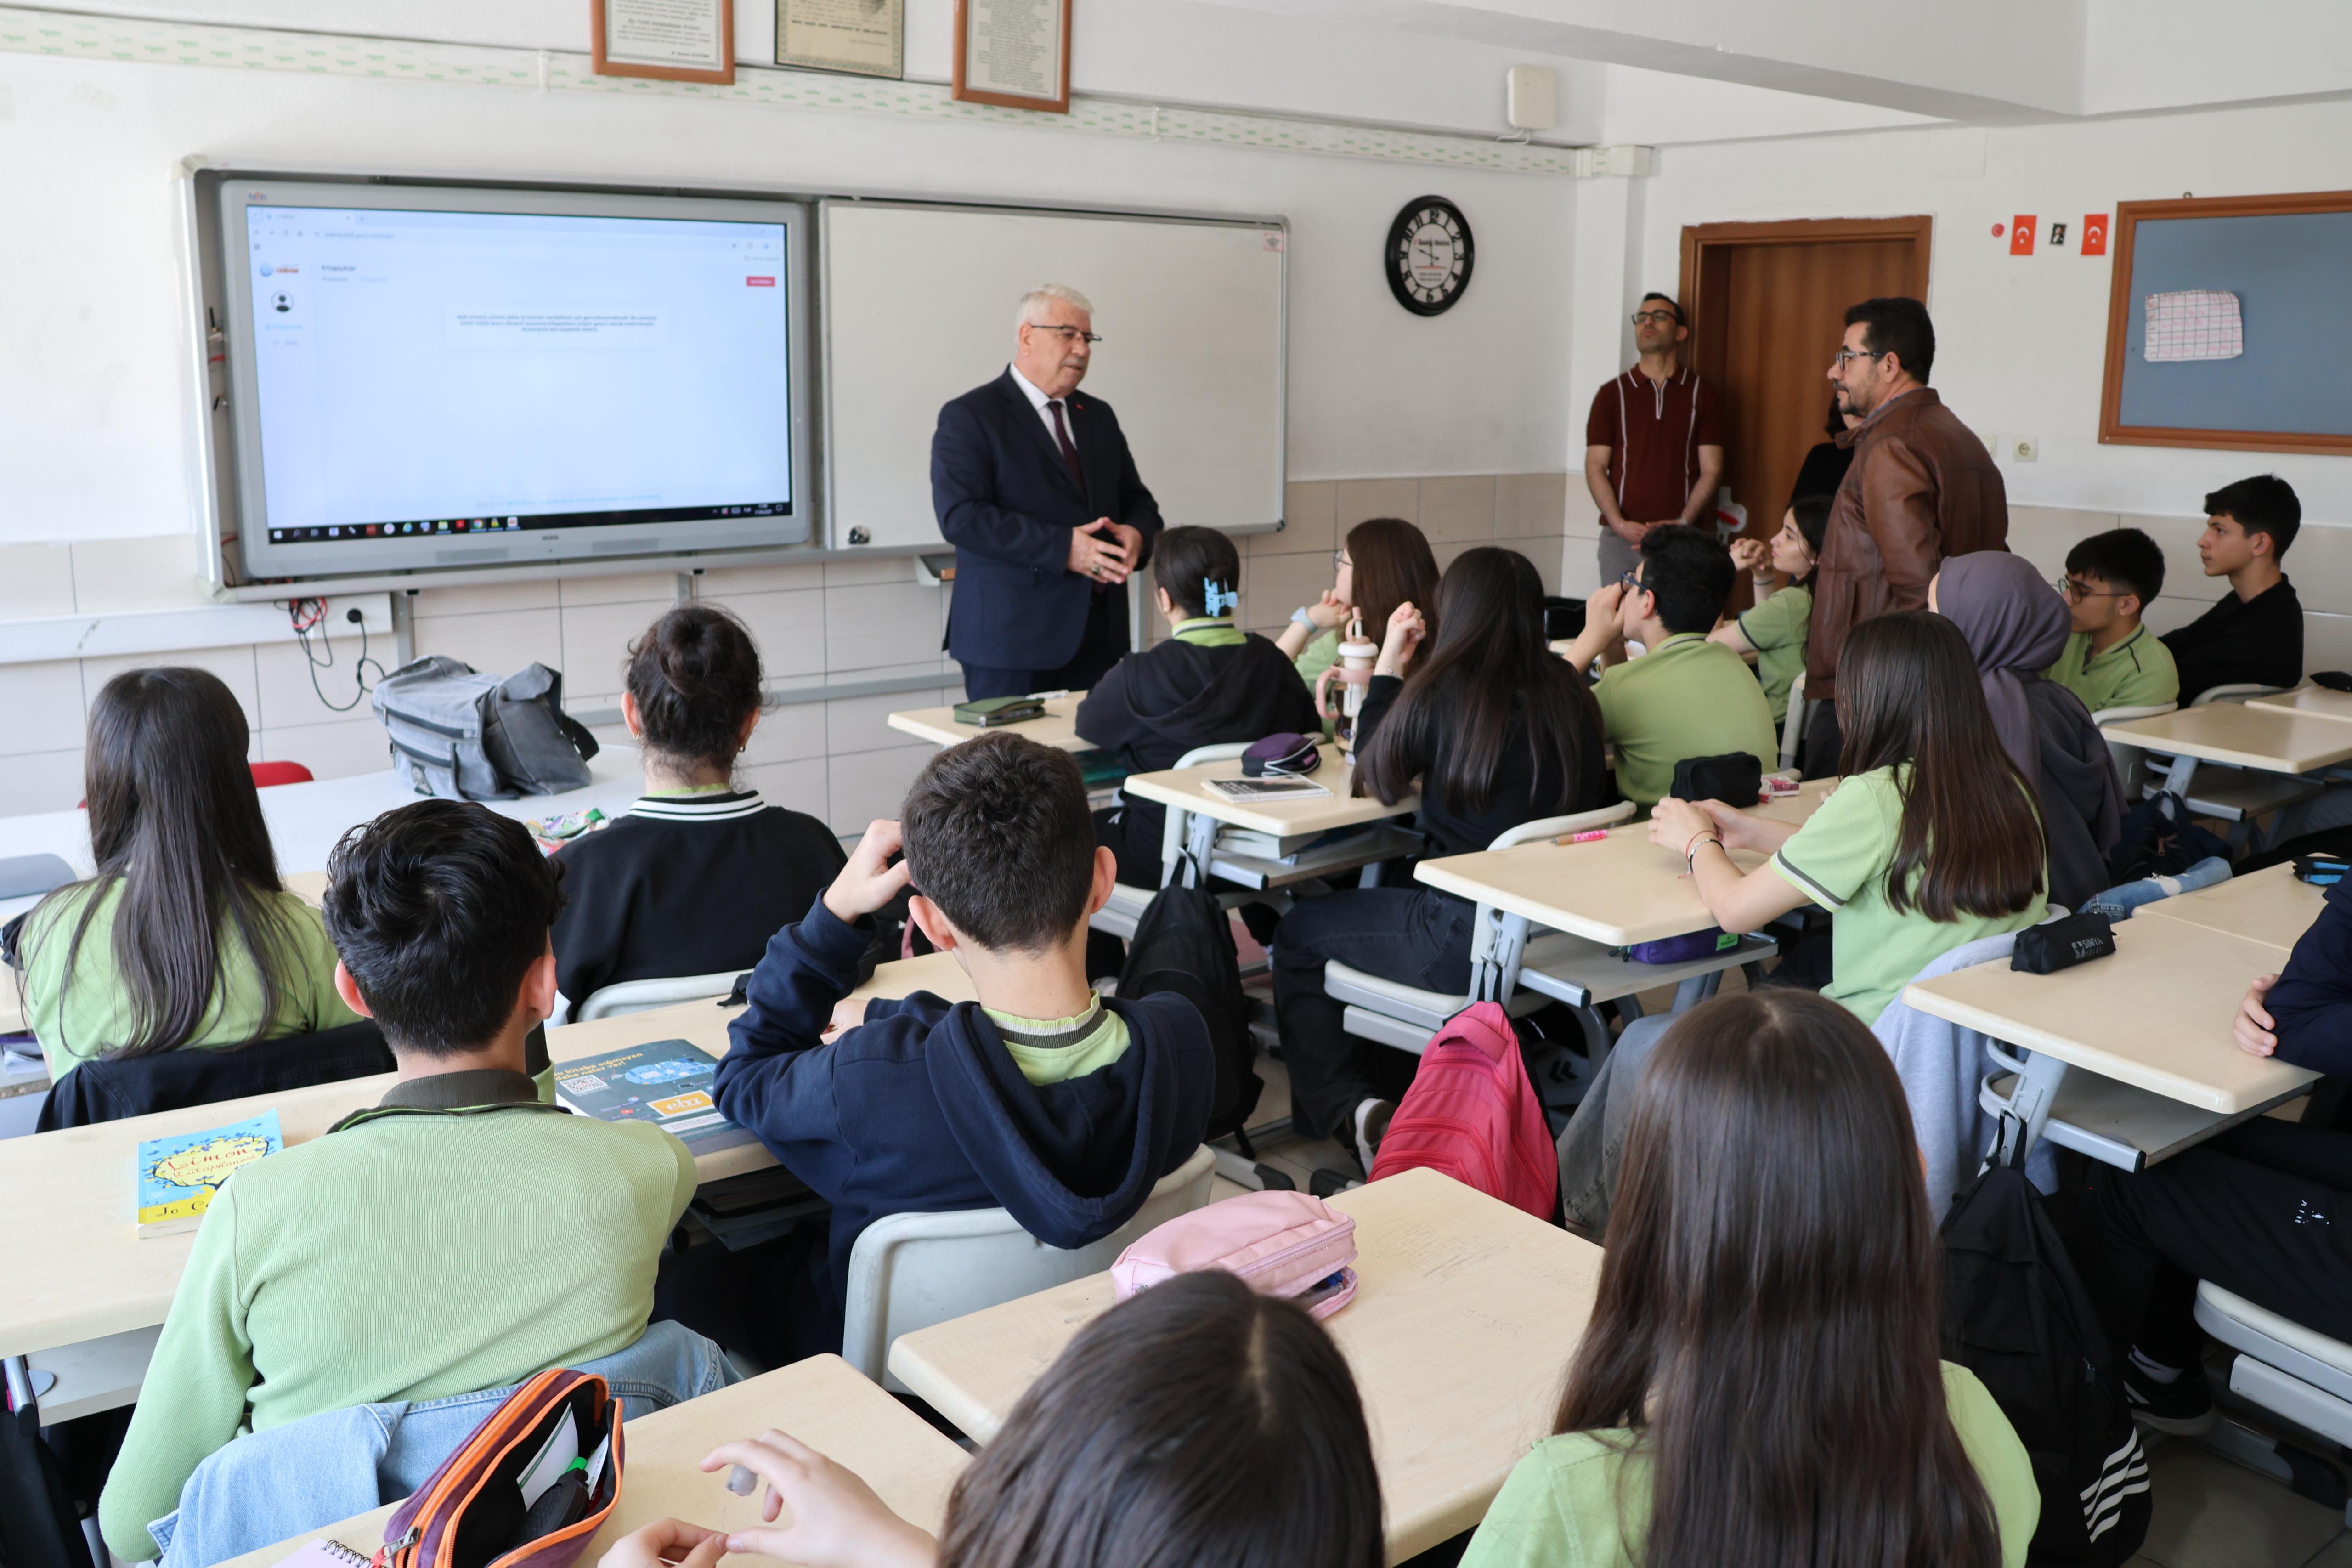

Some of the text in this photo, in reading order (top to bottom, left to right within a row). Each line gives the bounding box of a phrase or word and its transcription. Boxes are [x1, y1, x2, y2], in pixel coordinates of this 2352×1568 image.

[667, 1097, 702, 1110] eba
[167, 1148, 254, 1171] Limon
[156, 1207, 178, 1217] Jo
